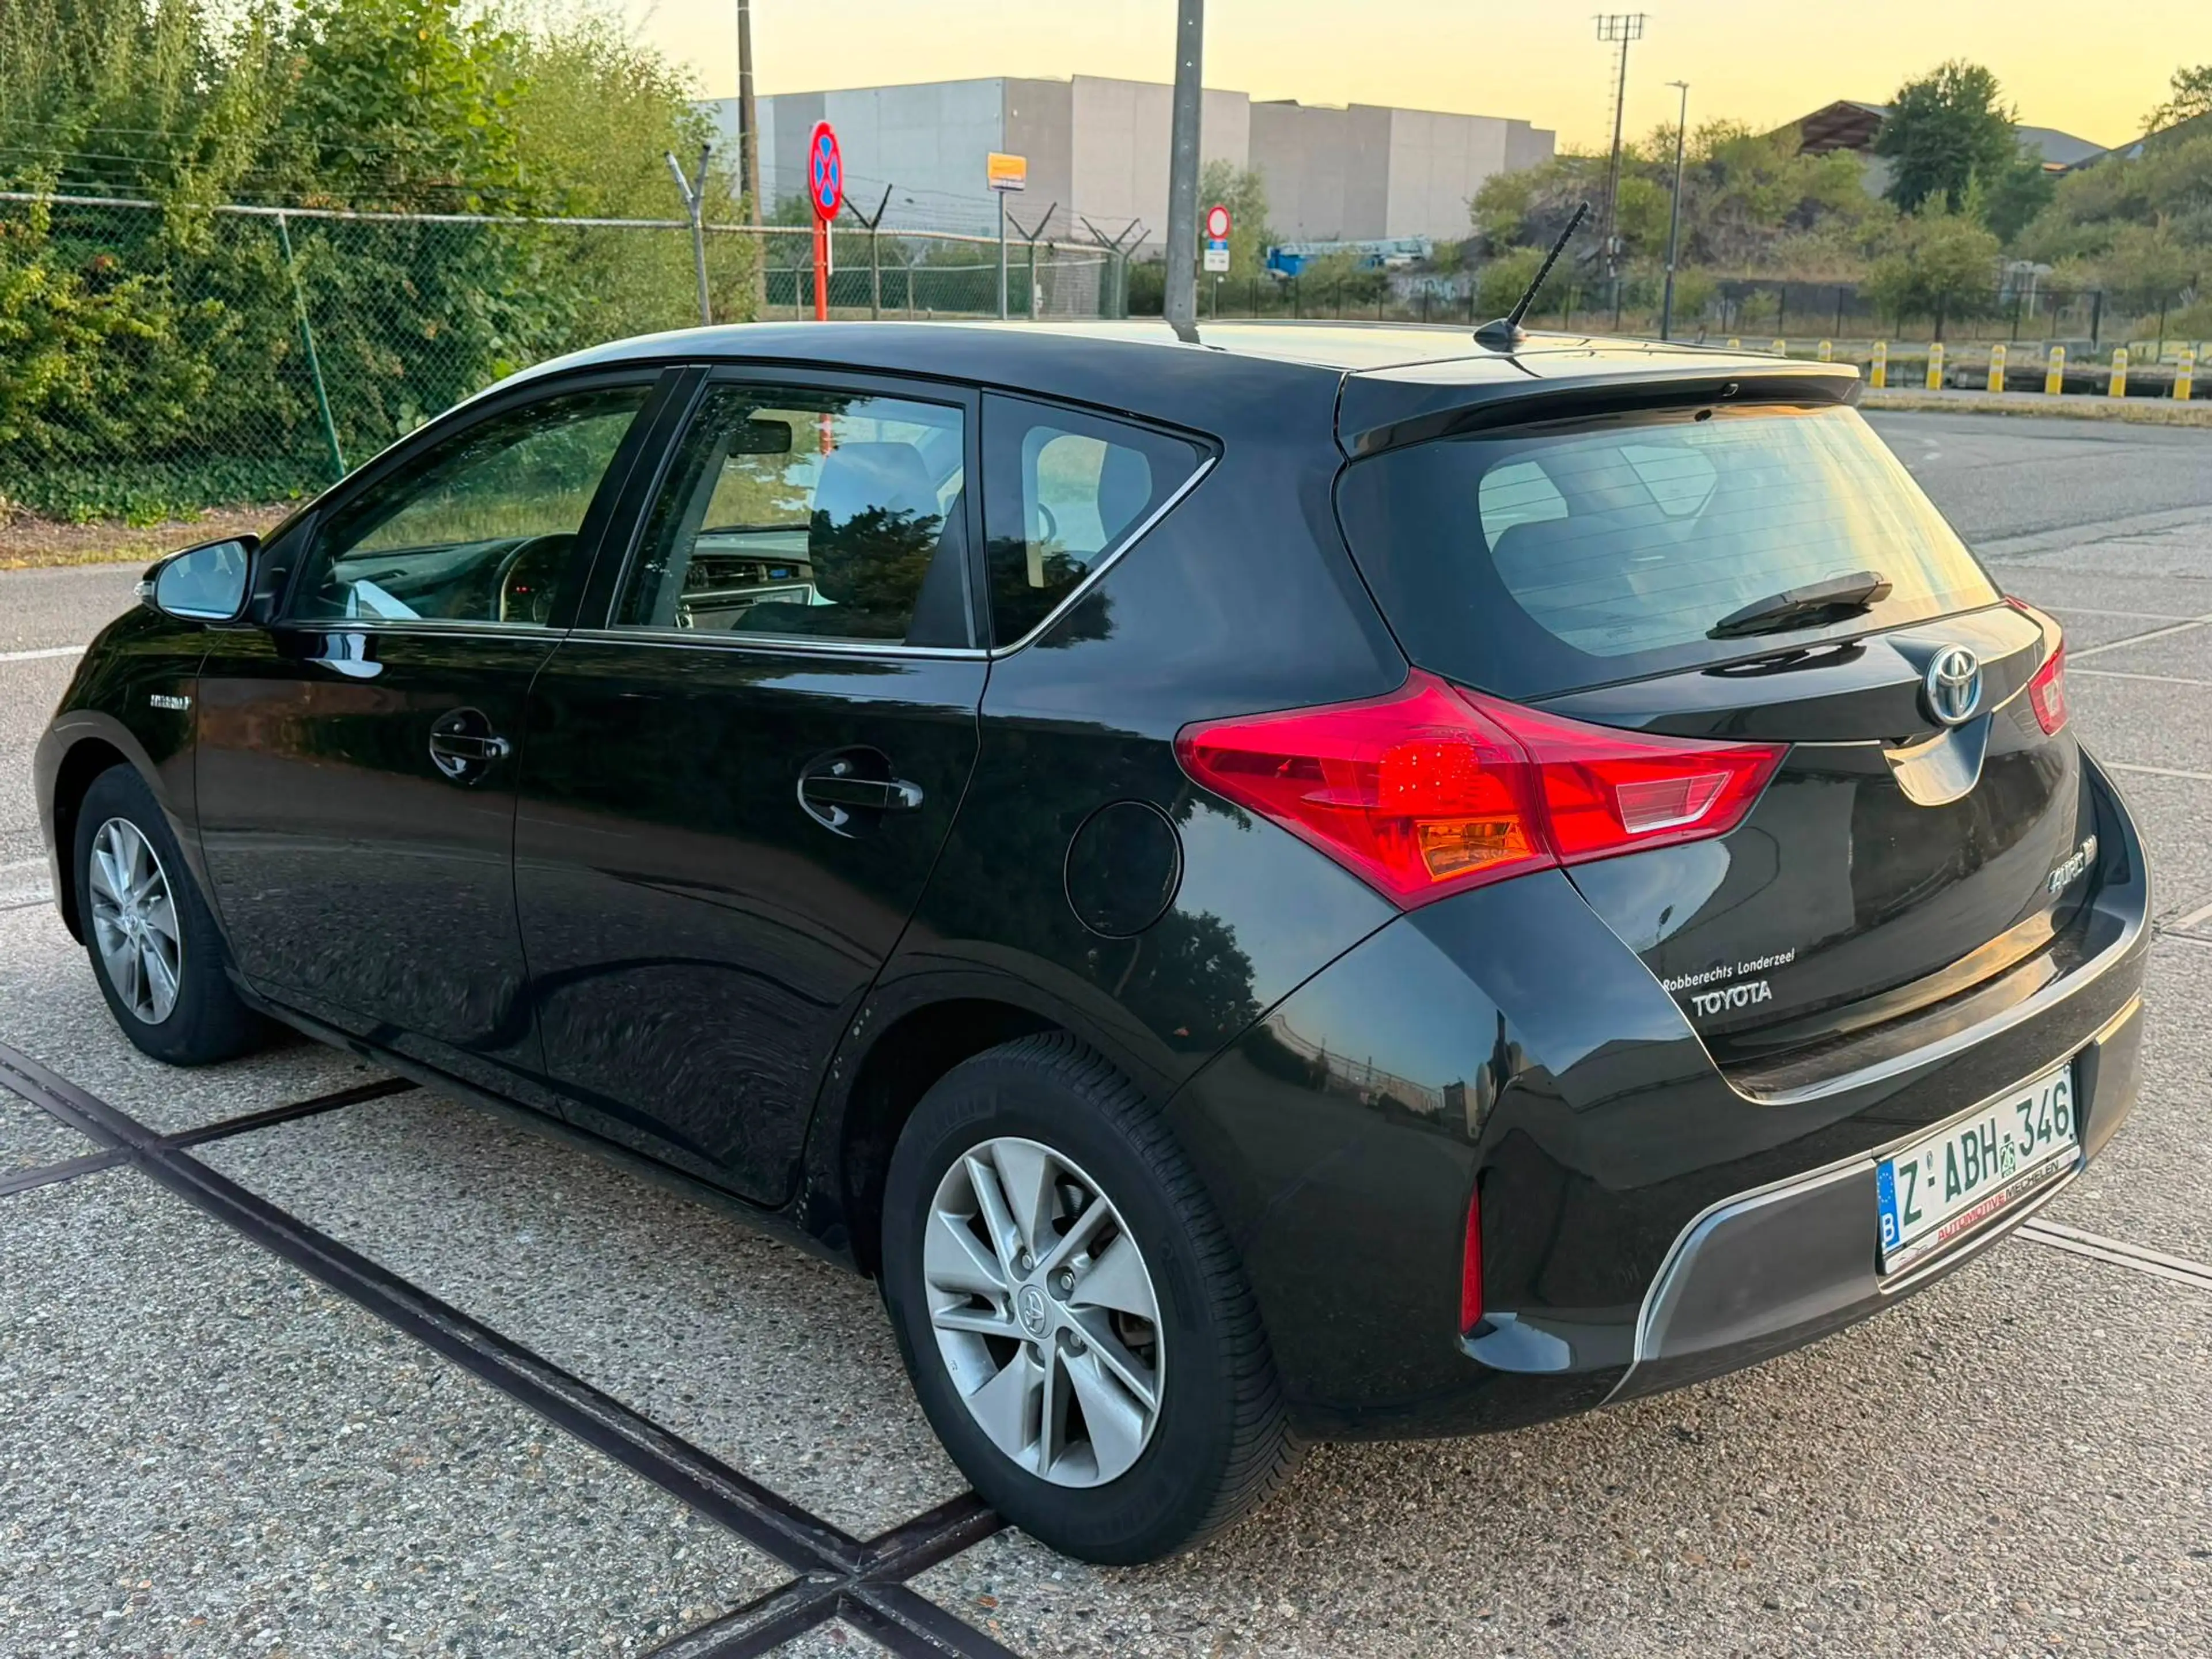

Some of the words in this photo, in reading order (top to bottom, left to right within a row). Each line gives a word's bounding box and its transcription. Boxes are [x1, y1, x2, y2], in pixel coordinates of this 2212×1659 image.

[1663, 966, 1733, 992] Robberechts
[1737, 948, 1795, 975] Londerzeel
[1692, 980, 1772, 1017] TOYOTA
[2006, 1160, 2059, 1199] MECHELEN
[1882, 1213, 1895, 1243] B
